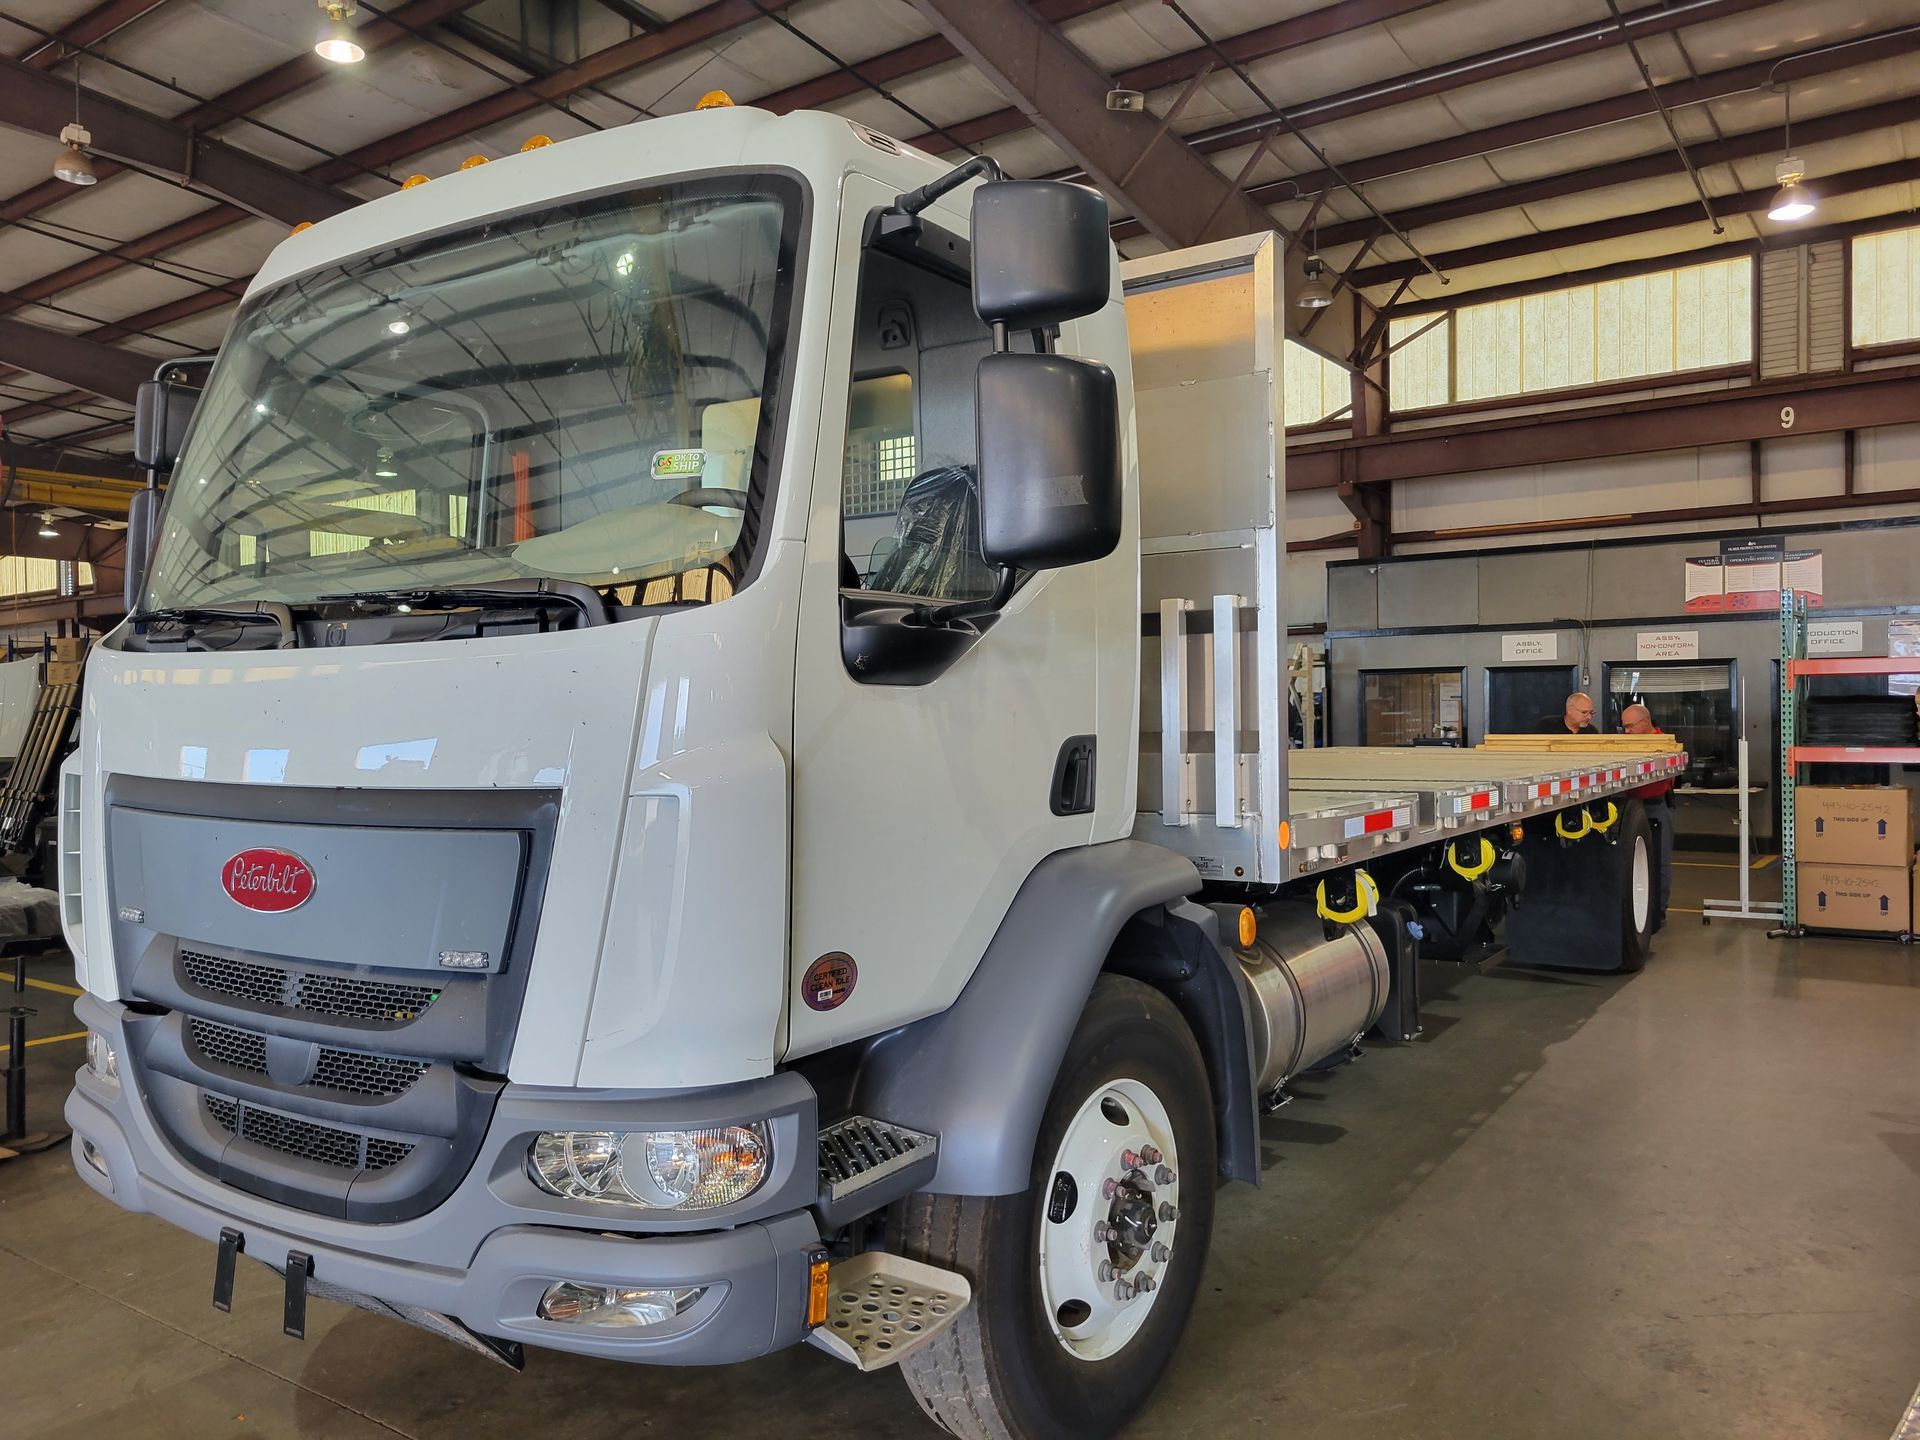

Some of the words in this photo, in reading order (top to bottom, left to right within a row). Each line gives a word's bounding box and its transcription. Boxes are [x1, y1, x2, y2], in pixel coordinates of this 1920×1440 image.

[1780, 406, 1794, 428] 9
[688, 453, 699, 461] TO
[672, 461, 699, 470] SHIP
[230, 857, 305, 894] Peterbilt
[813, 968, 848, 981] CERTIFIED
[810, 980, 834, 991] CLEAN
[835, 975, 851, 985] IDLE
